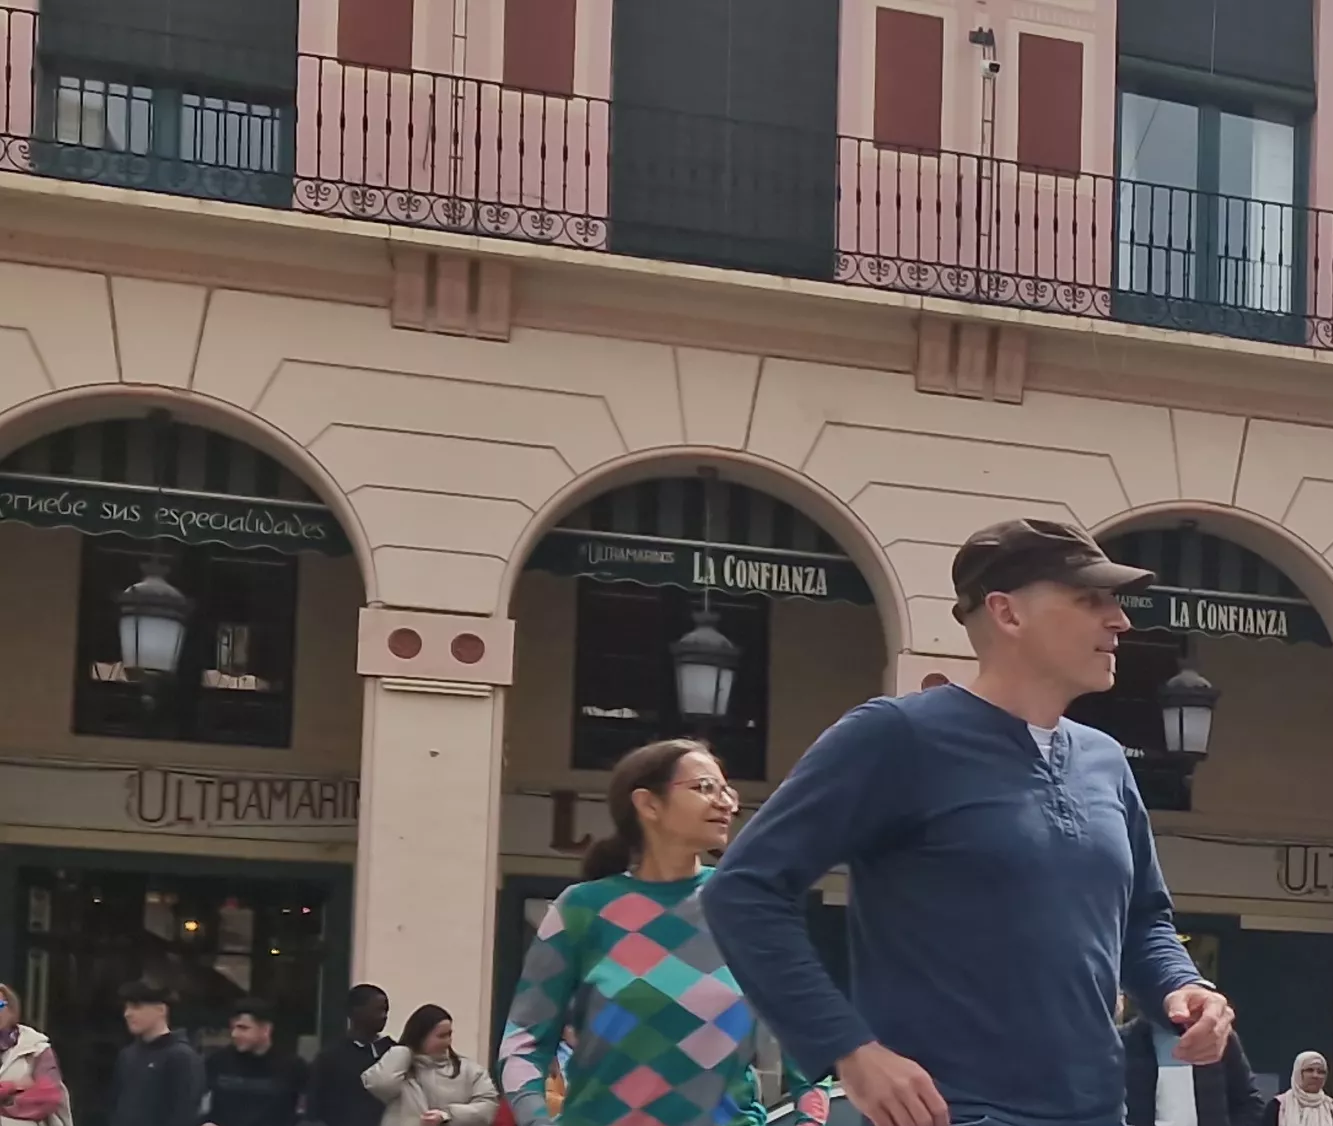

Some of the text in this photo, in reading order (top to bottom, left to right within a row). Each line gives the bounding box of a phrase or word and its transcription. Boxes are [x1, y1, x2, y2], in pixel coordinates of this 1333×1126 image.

[100, 502, 141, 522] sus
[155, 506, 326, 540] especialidades
[692, 551, 716, 586] LA
[723, 554, 828, 597] CONFIANZA
[1170, 596, 1190, 628] LA
[1197, 599, 1288, 637] CONFIANZA
